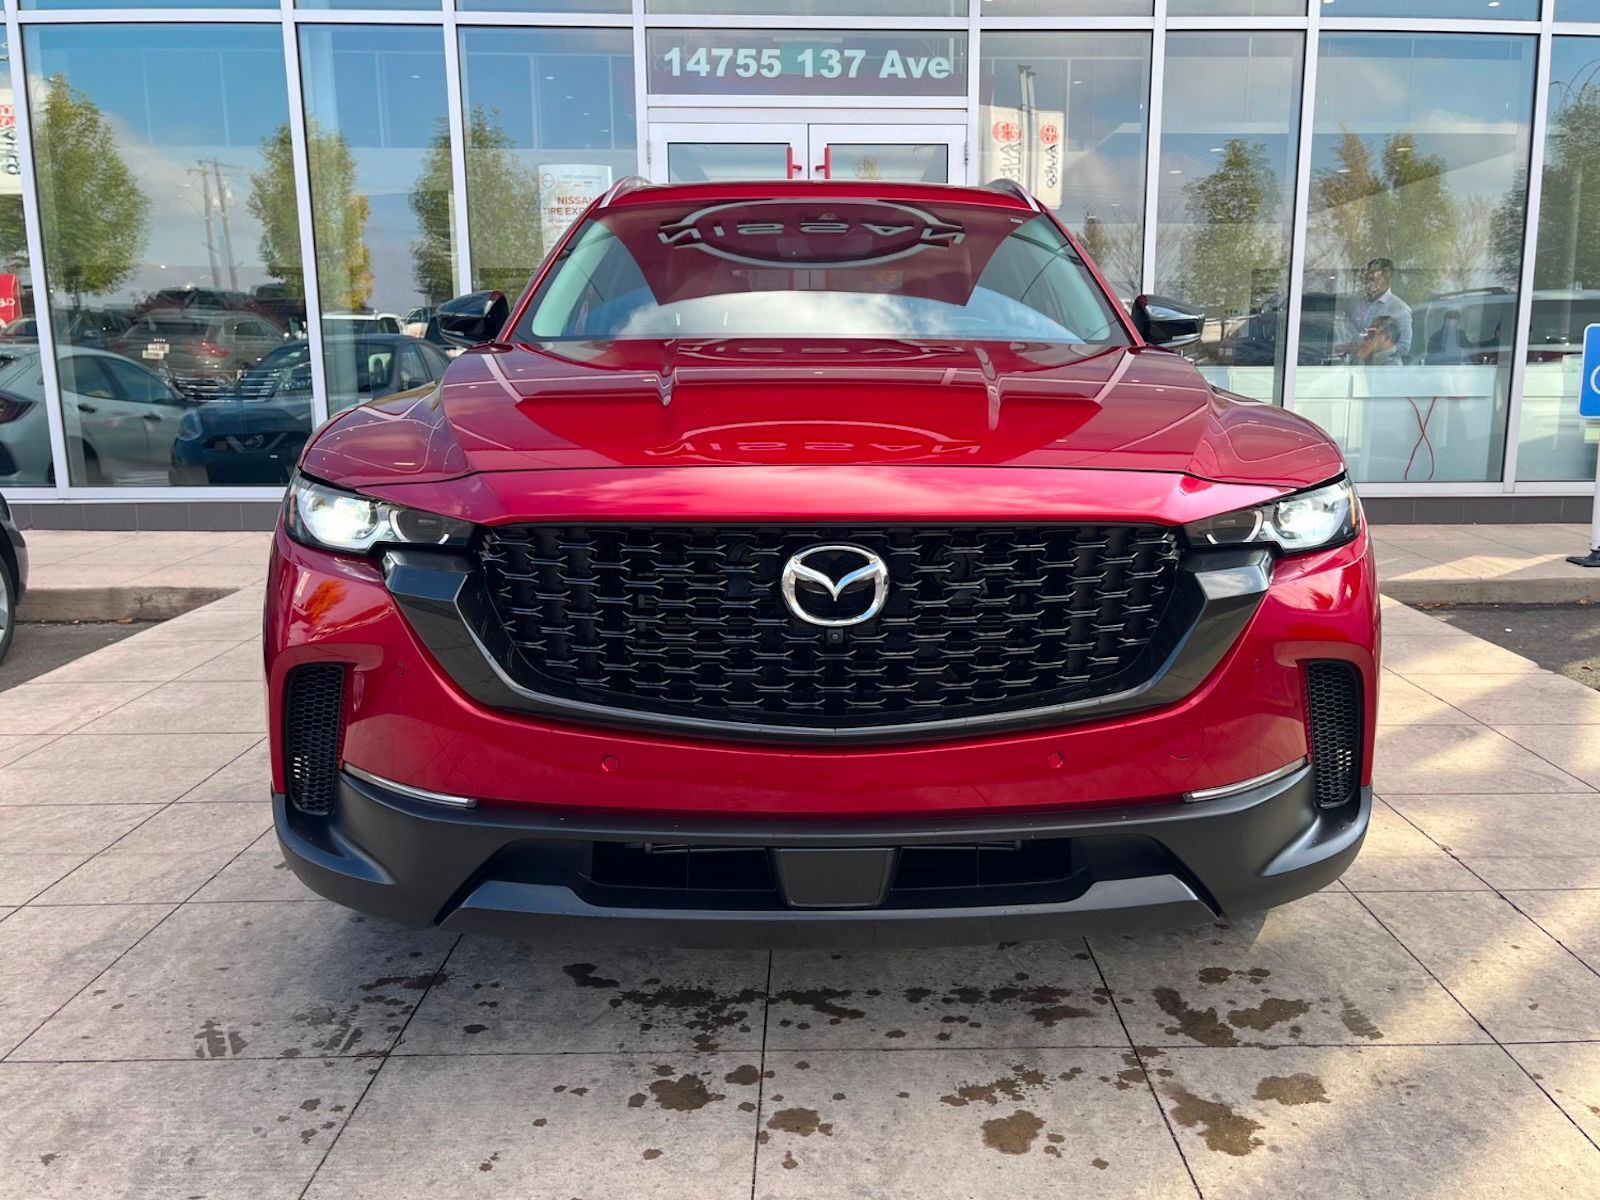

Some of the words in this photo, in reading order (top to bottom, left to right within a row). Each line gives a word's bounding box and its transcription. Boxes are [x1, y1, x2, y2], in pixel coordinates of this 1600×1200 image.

[664, 47, 781, 78] 14755
[797, 48, 866, 79] 137
[879, 49, 951, 79] Ave
